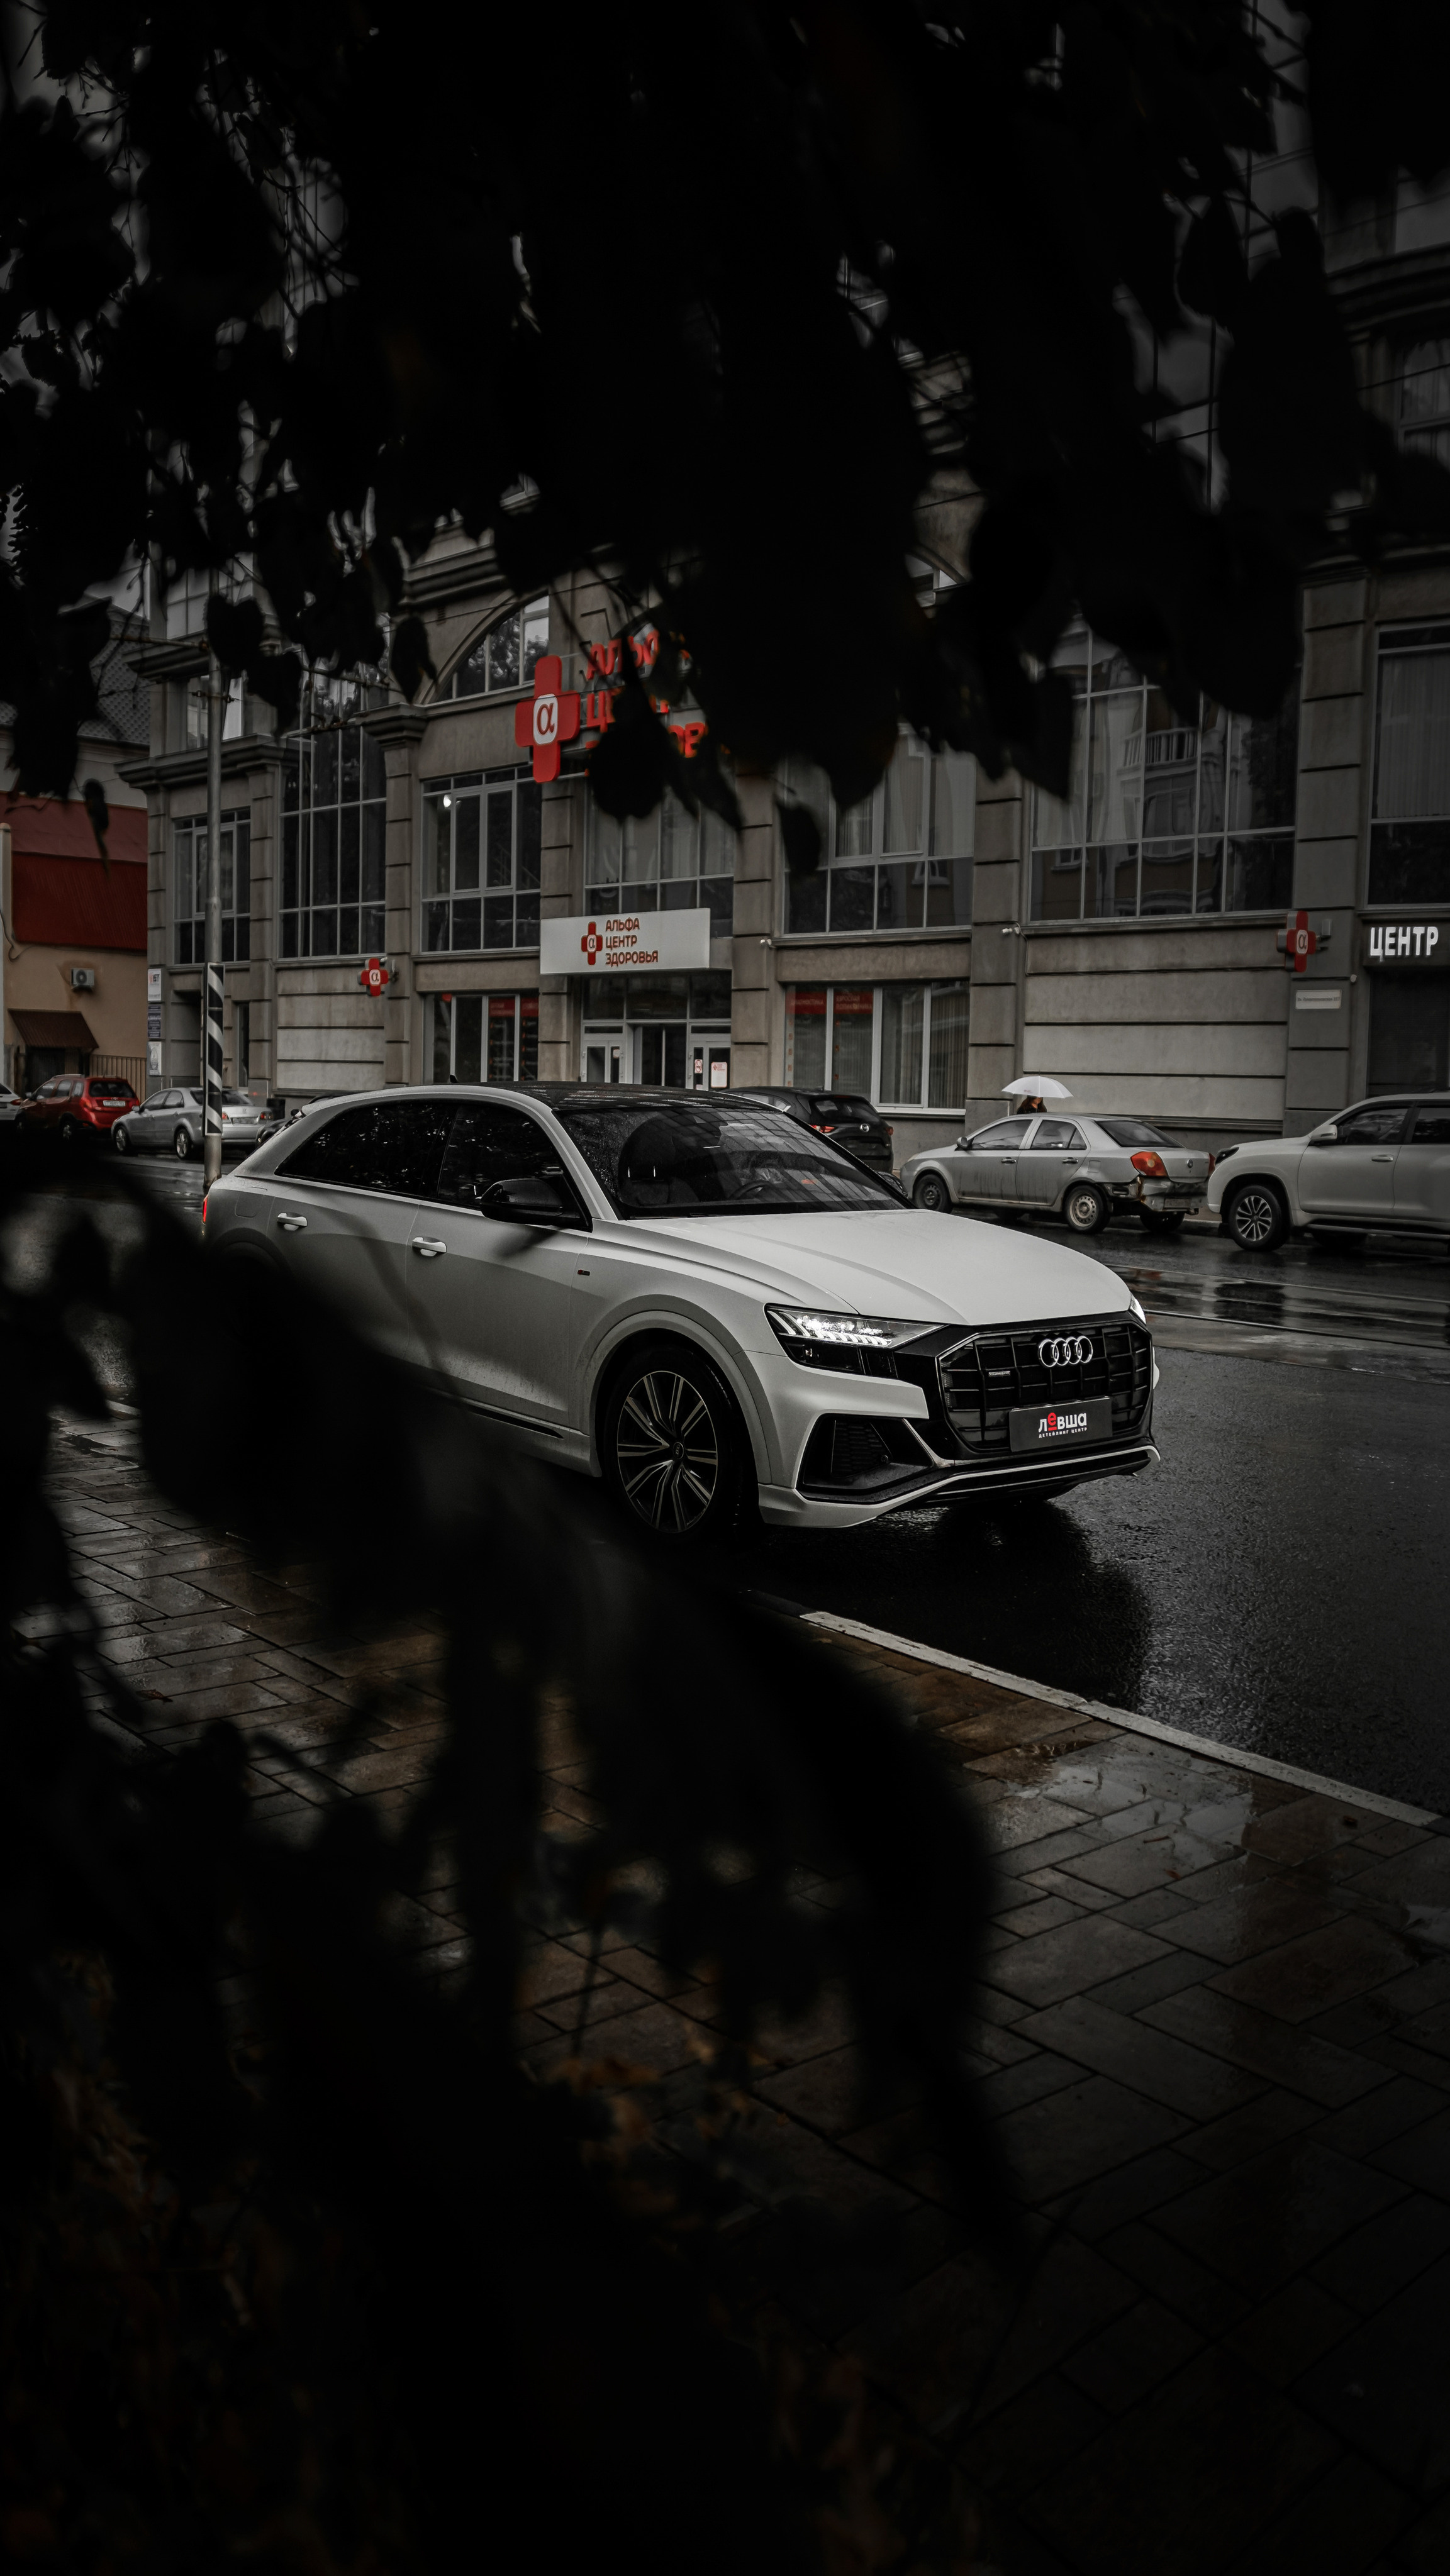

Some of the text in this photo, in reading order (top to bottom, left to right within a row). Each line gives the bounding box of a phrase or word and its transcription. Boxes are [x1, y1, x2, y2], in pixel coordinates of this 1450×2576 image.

[605, 918, 640, 931] АЛЬФА
[606, 935, 637, 950] ЦЕНТР
[1370, 926, 1439, 962] ЦЕНТР
[605, 950, 658, 967] ЗДОРОВЬЯ
[1039, 1430, 1069, 1438] ДЕТЕЙЛИНГ
